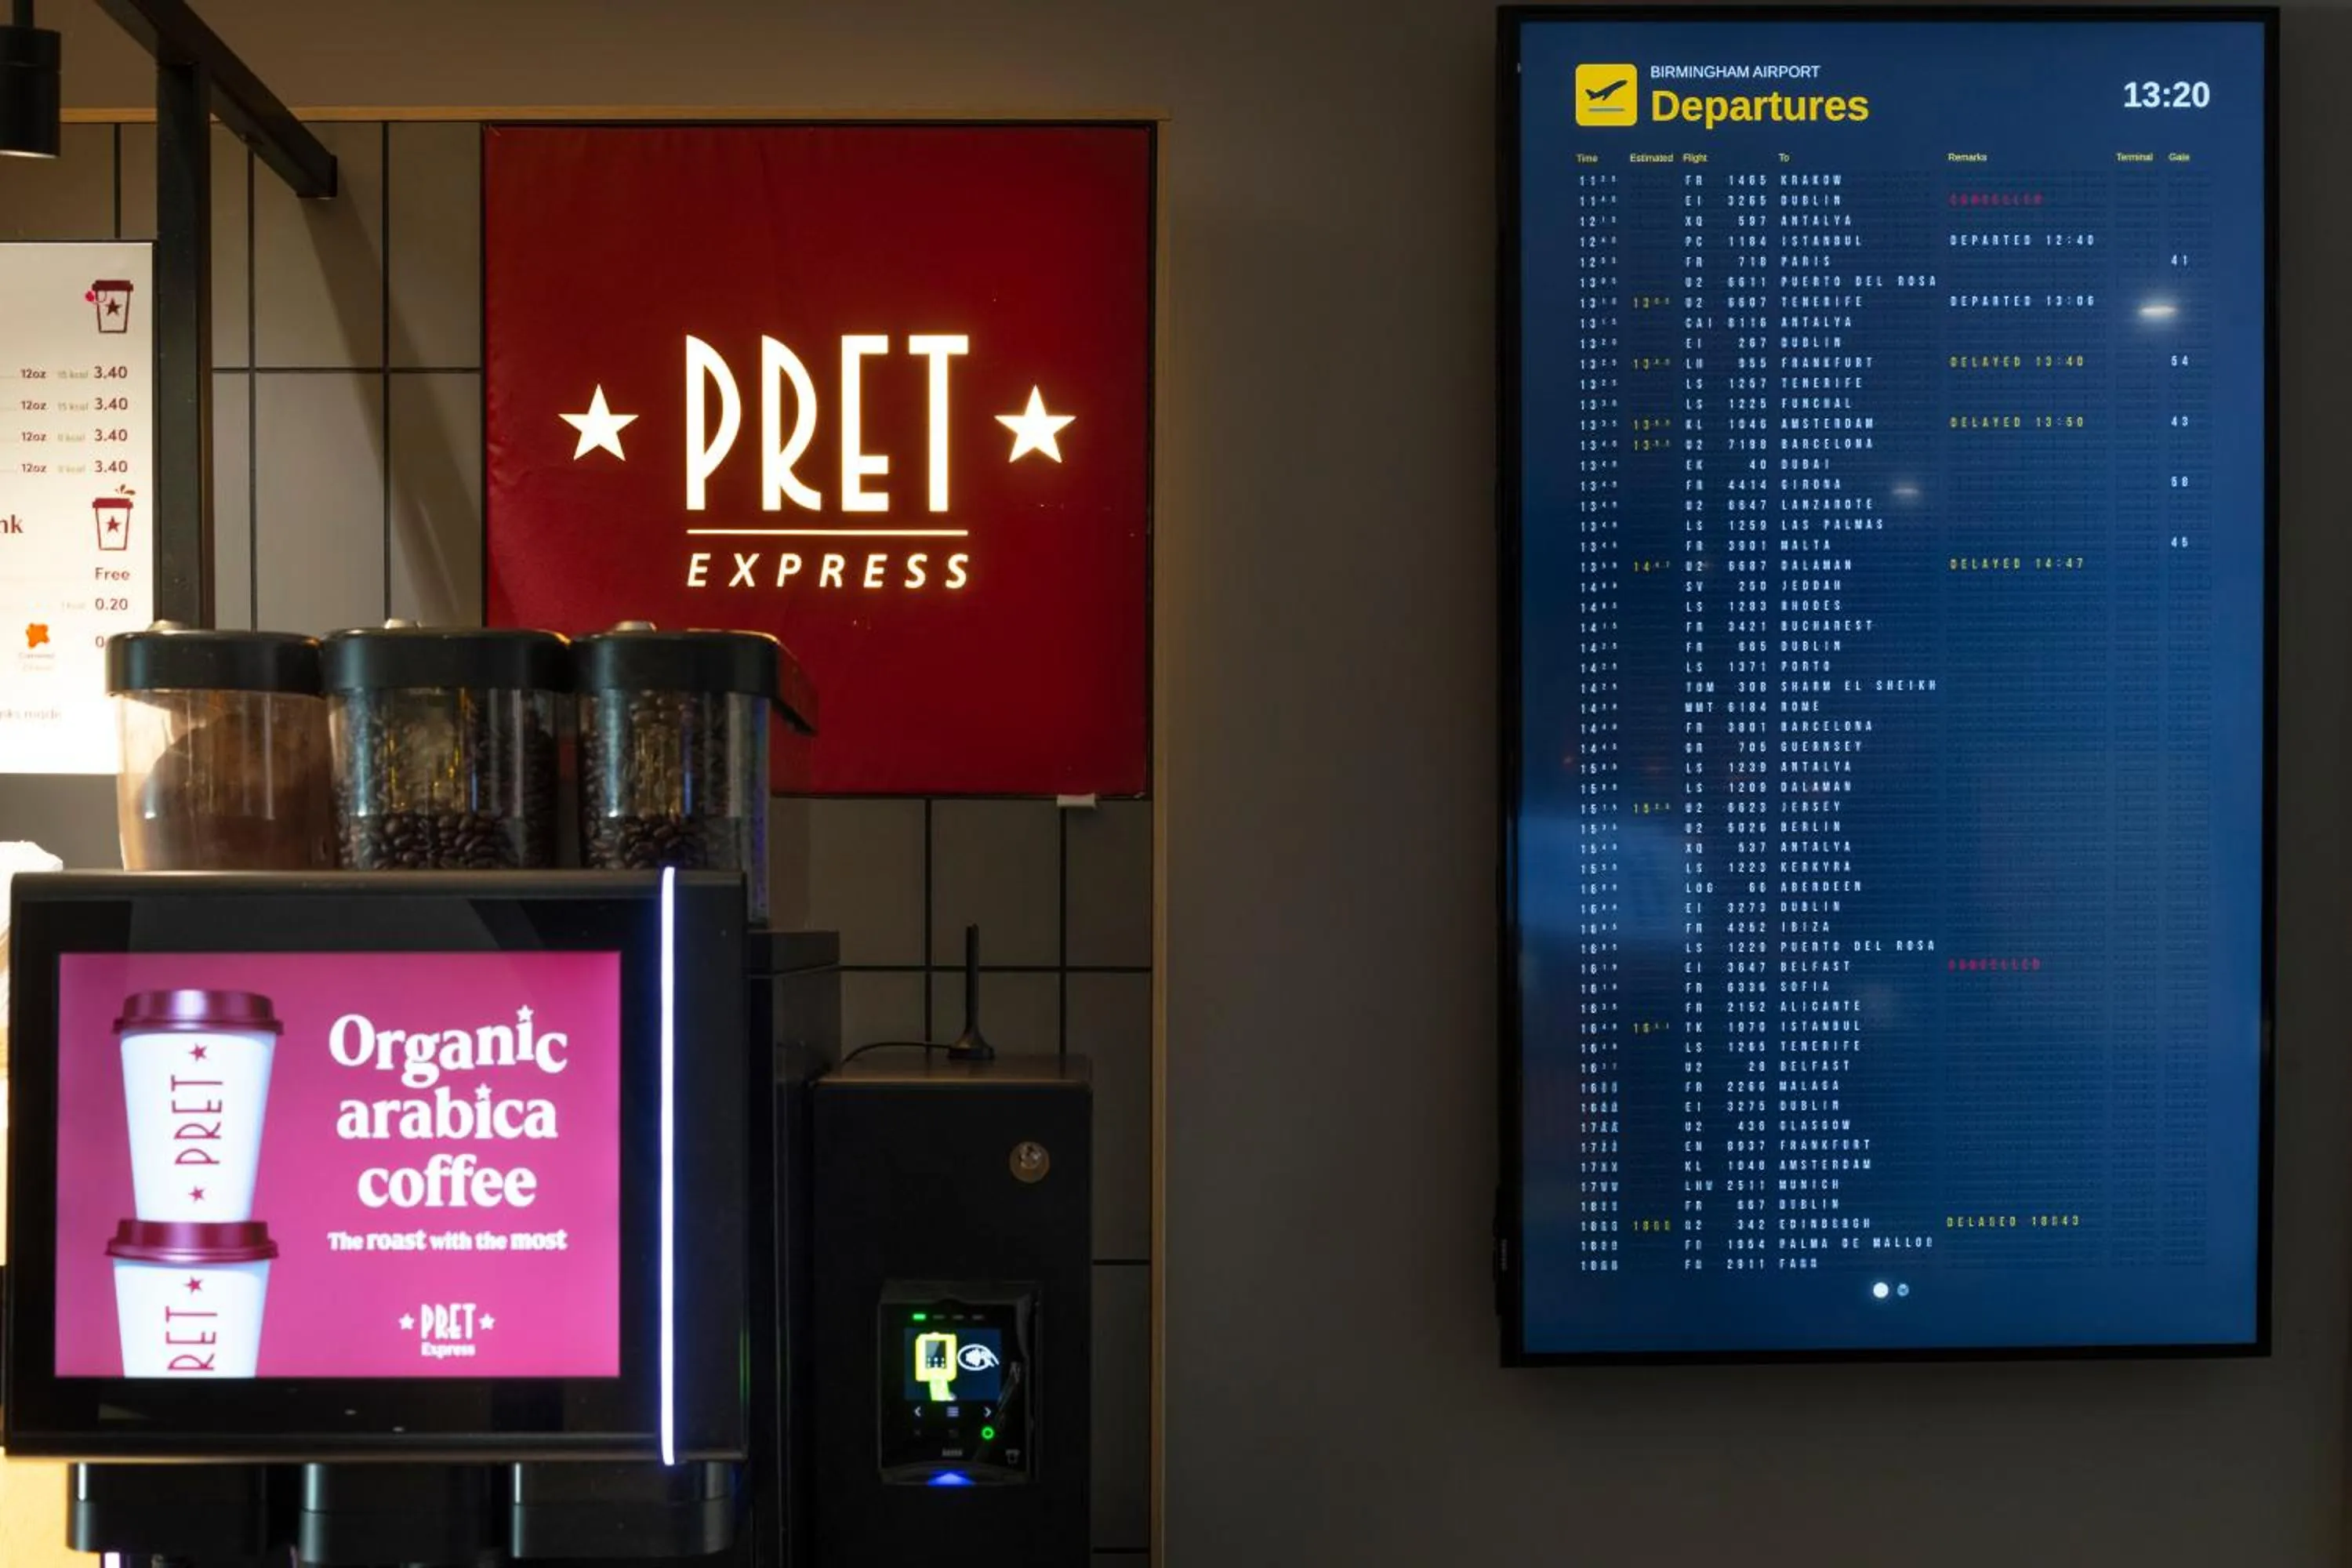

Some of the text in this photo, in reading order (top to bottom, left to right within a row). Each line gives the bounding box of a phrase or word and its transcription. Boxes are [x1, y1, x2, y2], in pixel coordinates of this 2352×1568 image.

[1650, 65, 1821, 78] BIRMINGHAM AIRPORT
[2123, 81, 2211, 107] 13:20
[1652, 89, 1870, 129] Departures
[1576, 152, 2190, 164] Time Estimated Flight To Remarks Terminal Gate
[1780, 174, 1842, 186] KRAKOW
[1780, 194, 1841, 206] DUBLIN
[1780, 214, 1852, 227] ANTALYA
[1781, 234, 1861, 247] ISTANBUL
[1950, 234, 2032, 246] DEPARTED
[2046, 234, 2095, 246] 12:40
[1780, 254, 2188, 267] PARIS 41
[1780, 275, 1936, 288] PUERTO DEL ROSA
[1780, 296, 1862, 308] TENERIFE
[1950, 295, 2032, 307] DEPARTED
[1780, 316, 1852, 328] ANTALYA
[1780, 336, 1842, 348] DUBLIN
[1780, 357, 1872, 368] FRANKFURT
[1949, 355, 2021, 368] DELAYED
[2171, 354, 2189, 367] 54
[21, 368, 46, 379] 12oz
[93, 366, 128, 379] 3.40
[1686, 376, 1862, 390] LS TENERIFE
[21, 401, 47, 410] 12oz
[94, 397, 128, 410] 3.40
[686, 335, 969, 512] PRET
[1780, 417, 1874, 430] AMSTERDAM
[1949, 416, 2021, 428] DELAYED
[2170, 416, 2189, 427] 43
[21, 432, 46, 441] 12oz
[94, 429, 128, 441] 3.40
[1780, 437, 1873, 450] BARCELONA
[22, 463, 47, 473] 12oz
[94, 460, 128, 473] 3.40
[1749, 458, 1767, 470] 40
[1780, 458, 1829, 470] DUBAI
[1781, 498, 1873, 510] LANZAROTE
[1686, 519, 1703, 532] LS
[1781, 519, 1809, 531] LAS
[1823, 518, 1883, 531] PALMAS
[1780, 535, 2189, 551] MALTA 45
[688, 553, 969, 589] EXPRESS
[1780, 559, 1852, 572] DALAMAN
[1950, 557, 2020, 570] DELAYED
[95, 568, 130, 581] Free
[1781, 579, 1842, 592] JEDDAH
[95, 598, 129, 611] 0.20
[1686, 601, 1703, 612] LS
[1780, 599, 1841, 612] RHODES
[1780, 640, 1841, 652] DUBLIN
[1780, 660, 1831, 672] PORTO
[1780, 679, 1936, 692] SHARM EL SHEIKH
[1780, 700, 1819, 713] ROME
[1780, 720, 1872, 732] BARCELONA
[1780, 760, 1851, 772] ANTALYA
[1780, 780, 1852, 793] DALAMAN
[1781, 800, 1840, 813] JERSEY
[1780, 821, 1841, 833] BERLIN
[1780, 840, 1851, 853] ANTALYA
[1780, 880, 1861, 893] ABERDEEN
[1780, 900, 1841, 913] DUBLIN
[1781, 920, 1830, 933] IBIZA
[1780, 939, 1935, 953] PUERTO DEL ROSA
[1780, 960, 1850, 973] BELFAST
[1780, 980, 1830, 993] SOFIA
[1780, 1000, 1860, 1012] ALICANTE
[1780, 1020, 1859, 1033] ISTANBUL
[328, 1004, 568, 1088] Organic
[1780, 1040, 1860, 1052] TENERIFE
[1779, 1059, 1849, 1072] BELFAST
[1778, 1080, 1839, 1092] MALAGA
[336, 1083, 558, 1139] arabica
[1779, 1099, 1839, 1112] DUBLIN
[171, 1075, 223, 1165] PRET
[1779, 1119, 1851, 1131] GLASGOW
[1780, 1138, 1870, 1151] FRANKFURT
[1778, 1158, 1871, 1171] AMSTERDAM
[358, 1154, 538, 1208] coffee
[1778, 1178, 1839, 1191] MUNICH
[1778, 1198, 1839, 1210] DUBLIN
[328, 1229, 568, 1250] The roast with the most
[421, 1303, 477, 1340] PRET
[165, 1305, 217, 1370] RET
[421, 1342, 477, 1359] Express
